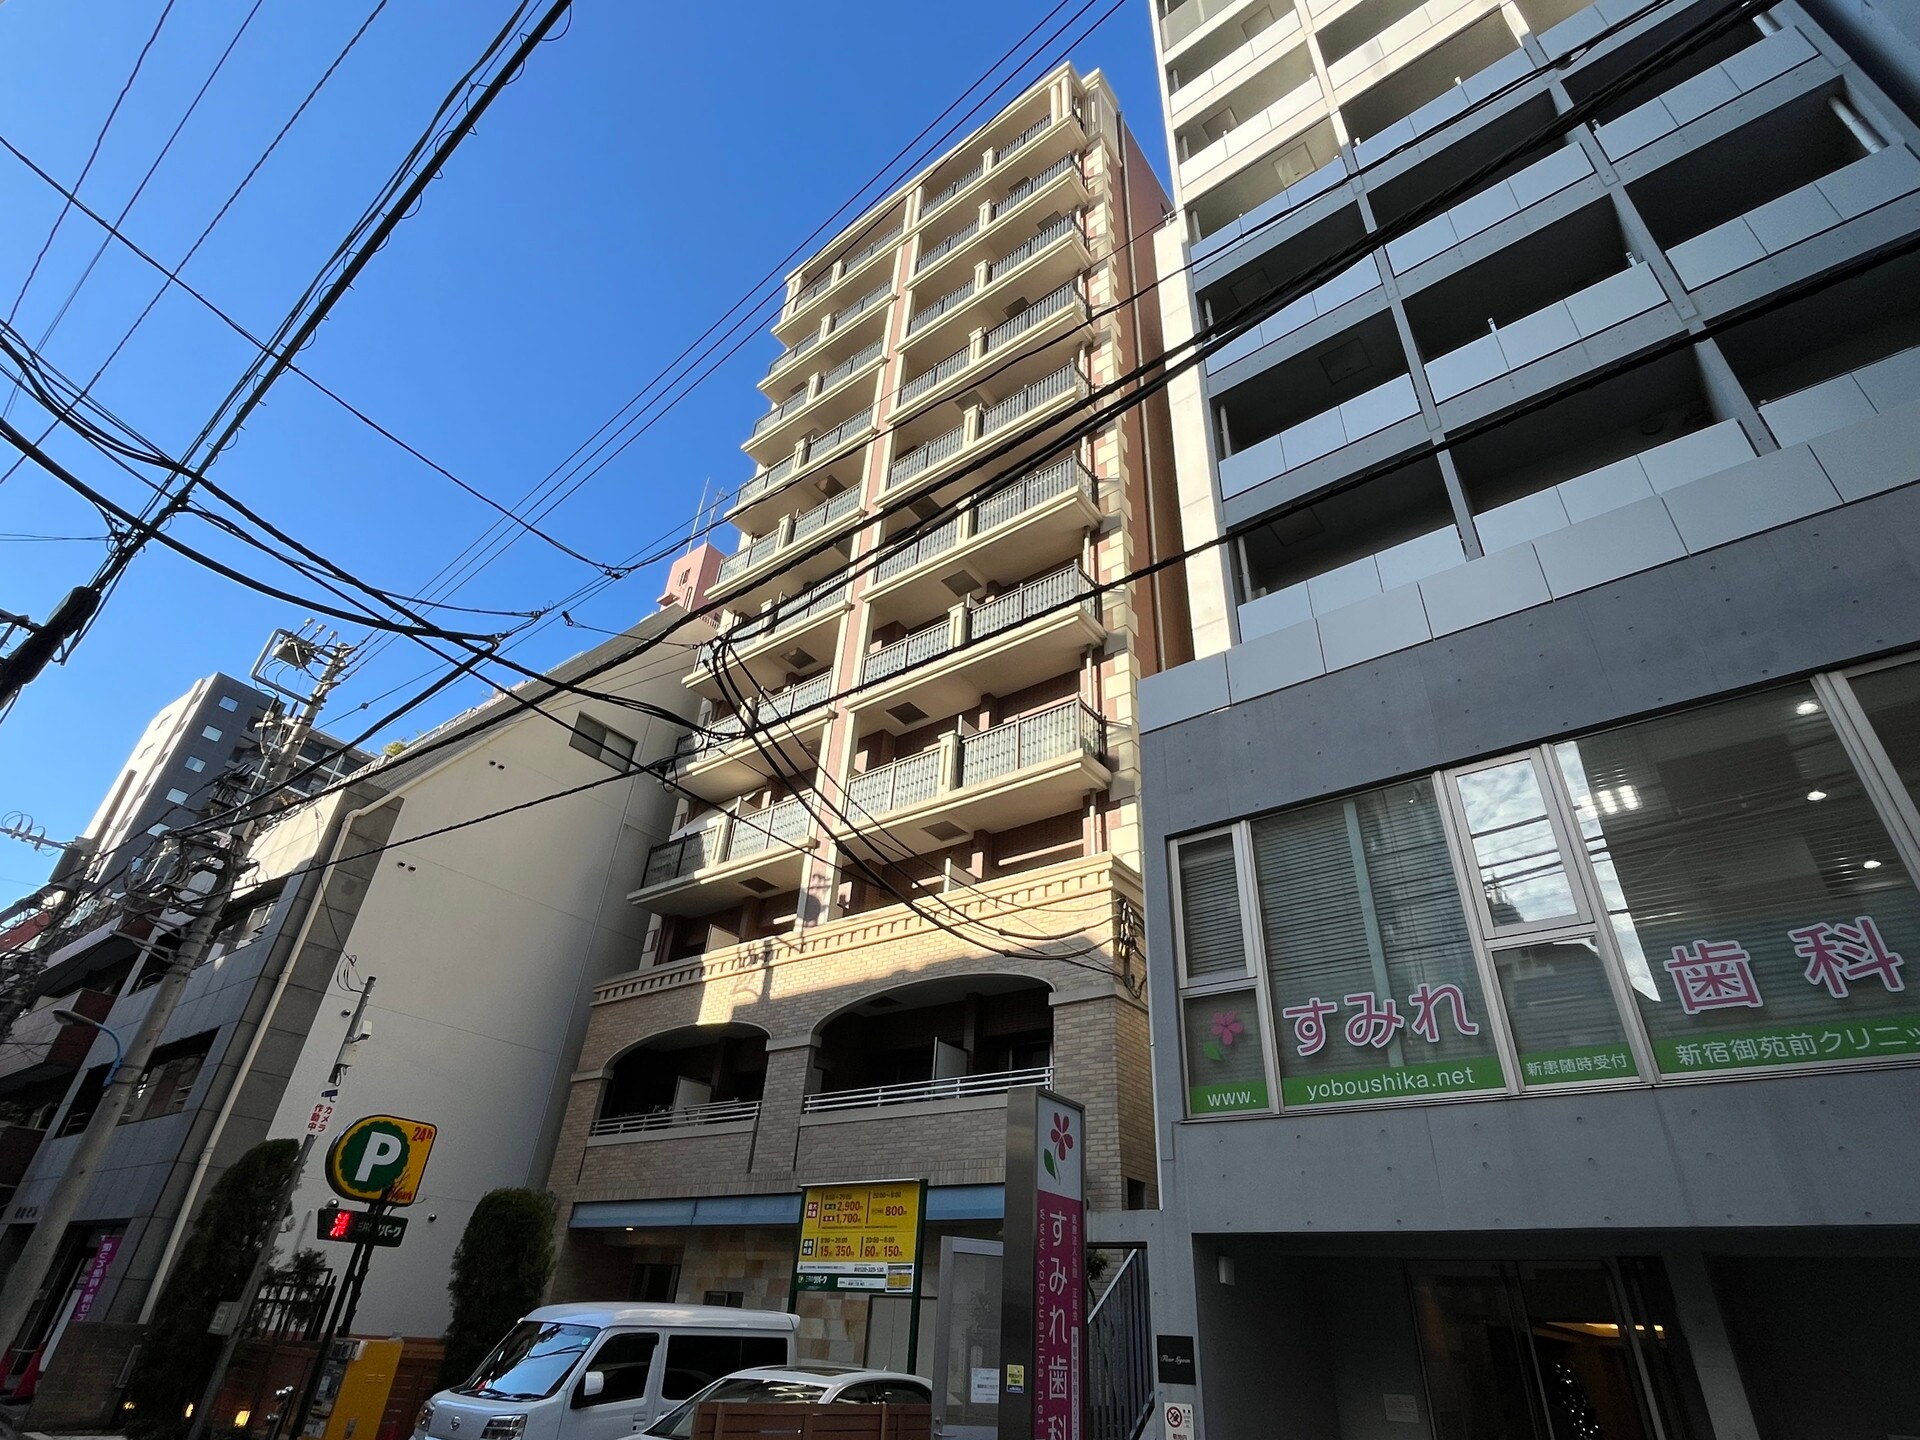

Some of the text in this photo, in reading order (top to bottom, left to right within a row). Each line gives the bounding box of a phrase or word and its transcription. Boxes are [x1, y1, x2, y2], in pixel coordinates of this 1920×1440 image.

[1283, 915, 1904, 1057] すみれ 歯科
[1527, 1051, 1627, 1078] 新患随時受付
[1207, 1065, 1475, 1107] www. yoboushika.net
[307, 1103, 324, 1131] 作動中
[318, 1106, 333, 1132] カメラ
[354, 1131, 402, 1182] P
